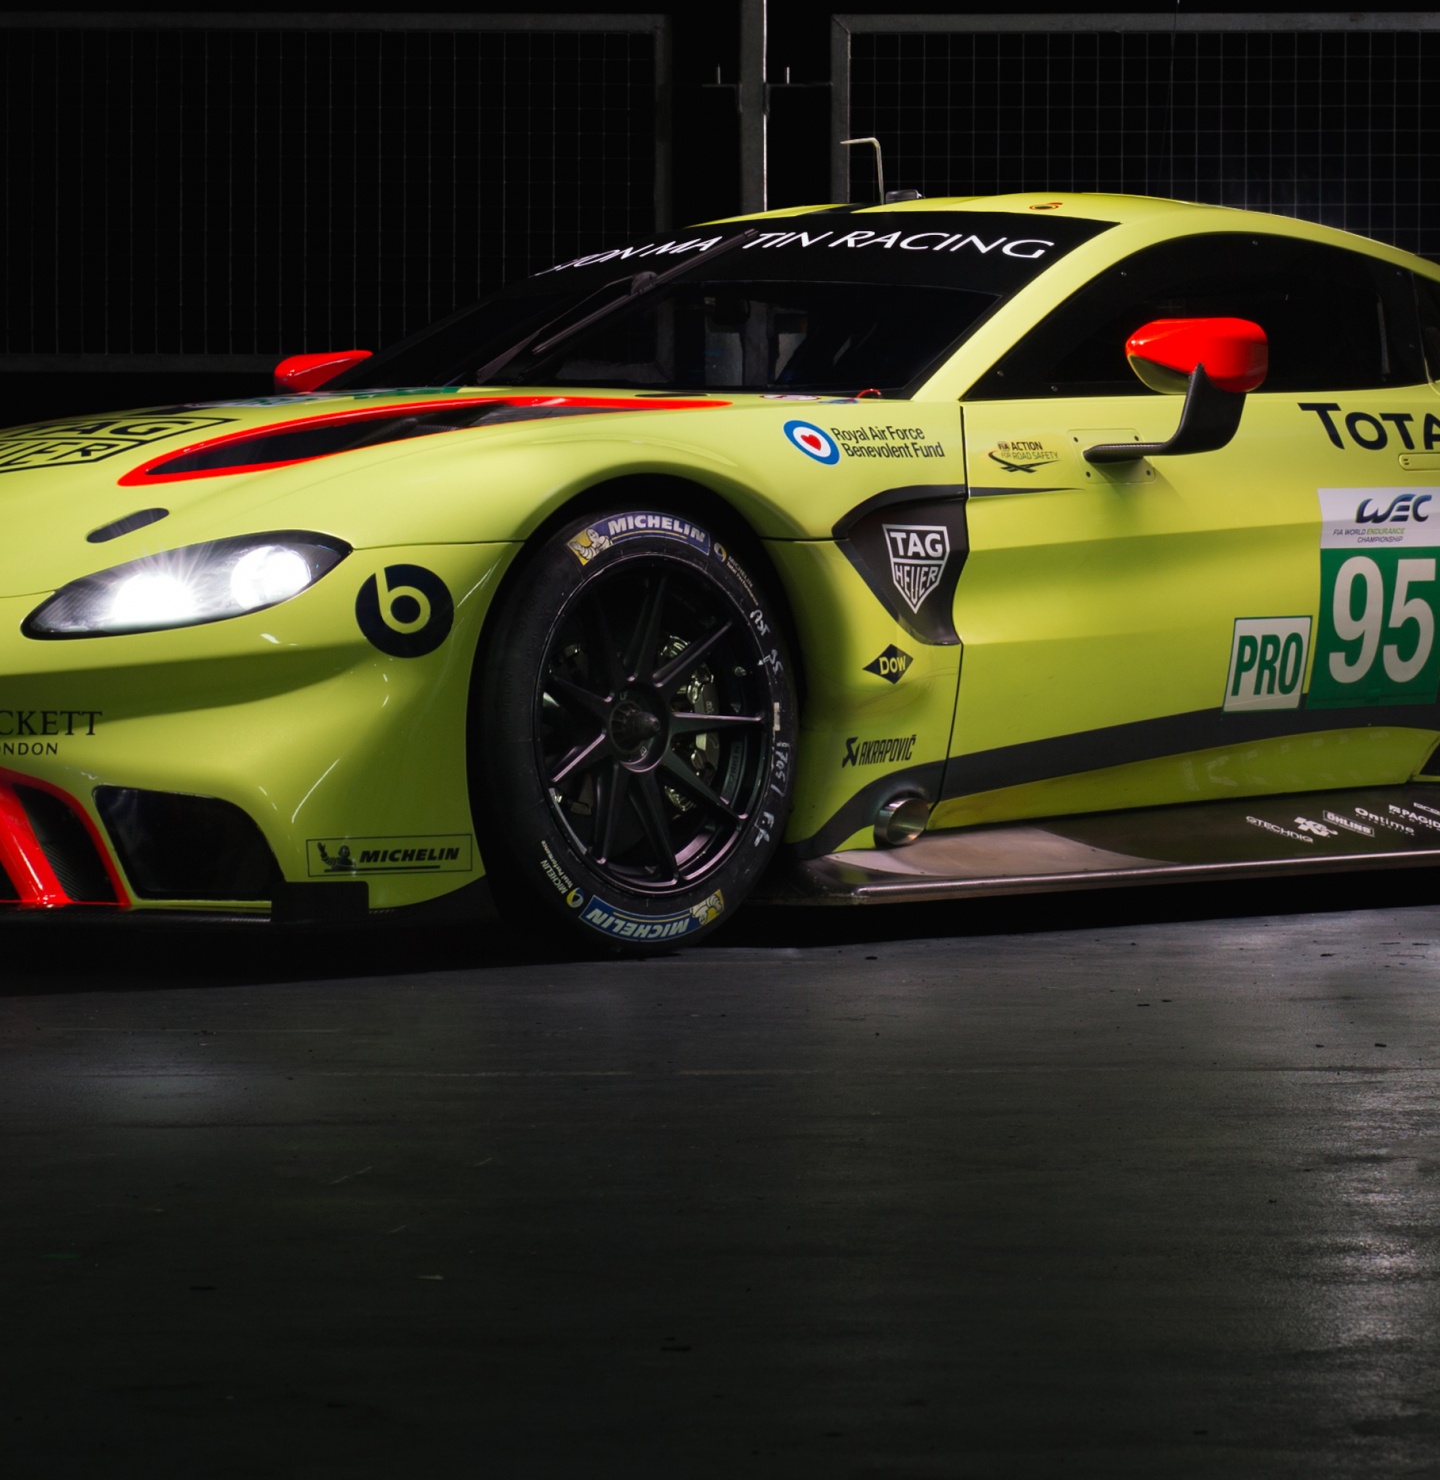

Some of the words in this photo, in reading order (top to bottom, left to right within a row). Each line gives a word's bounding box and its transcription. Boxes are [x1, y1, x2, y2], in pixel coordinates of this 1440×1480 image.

[638, 231, 834, 258] MATIN
[827, 231, 1055, 259] RACING
[830, 426, 869, 444] Royal
[868, 425, 888, 441] Air
[885, 425, 925, 441] Force
[1011, 441, 1043, 451] ACTION
[841, 442, 914, 458] Benevolent
[911, 441, 945, 457] Fund
[1012, 451, 1032, 460] ROAD
[1032, 451, 1059, 460] SAFETY
[1355, 493, 1433, 524] WEC
[608, 514, 705, 543] MICHELIN
[1333, 528, 1344, 536] FIA
[1344, 528, 1366, 536] WORLD
[1366, 527, 1405, 536] ENDURANCE
[889, 531, 943, 558] TAG
[895, 564, 939, 605] HEUER
[1328, 555, 1437, 685] 95
[879, 655, 906, 675] DOW
[1231, 632, 1303, 696] PRO
[0, 710, 103, 736] CKETT
[0, 742, 59, 756] NDON
[1401, 808, 1440, 828] PAGID
[359, 847, 460, 864] MICHELIN
[540, 859, 567, 894] MICHELIN
[586, 907, 690, 939] MICHELIN
